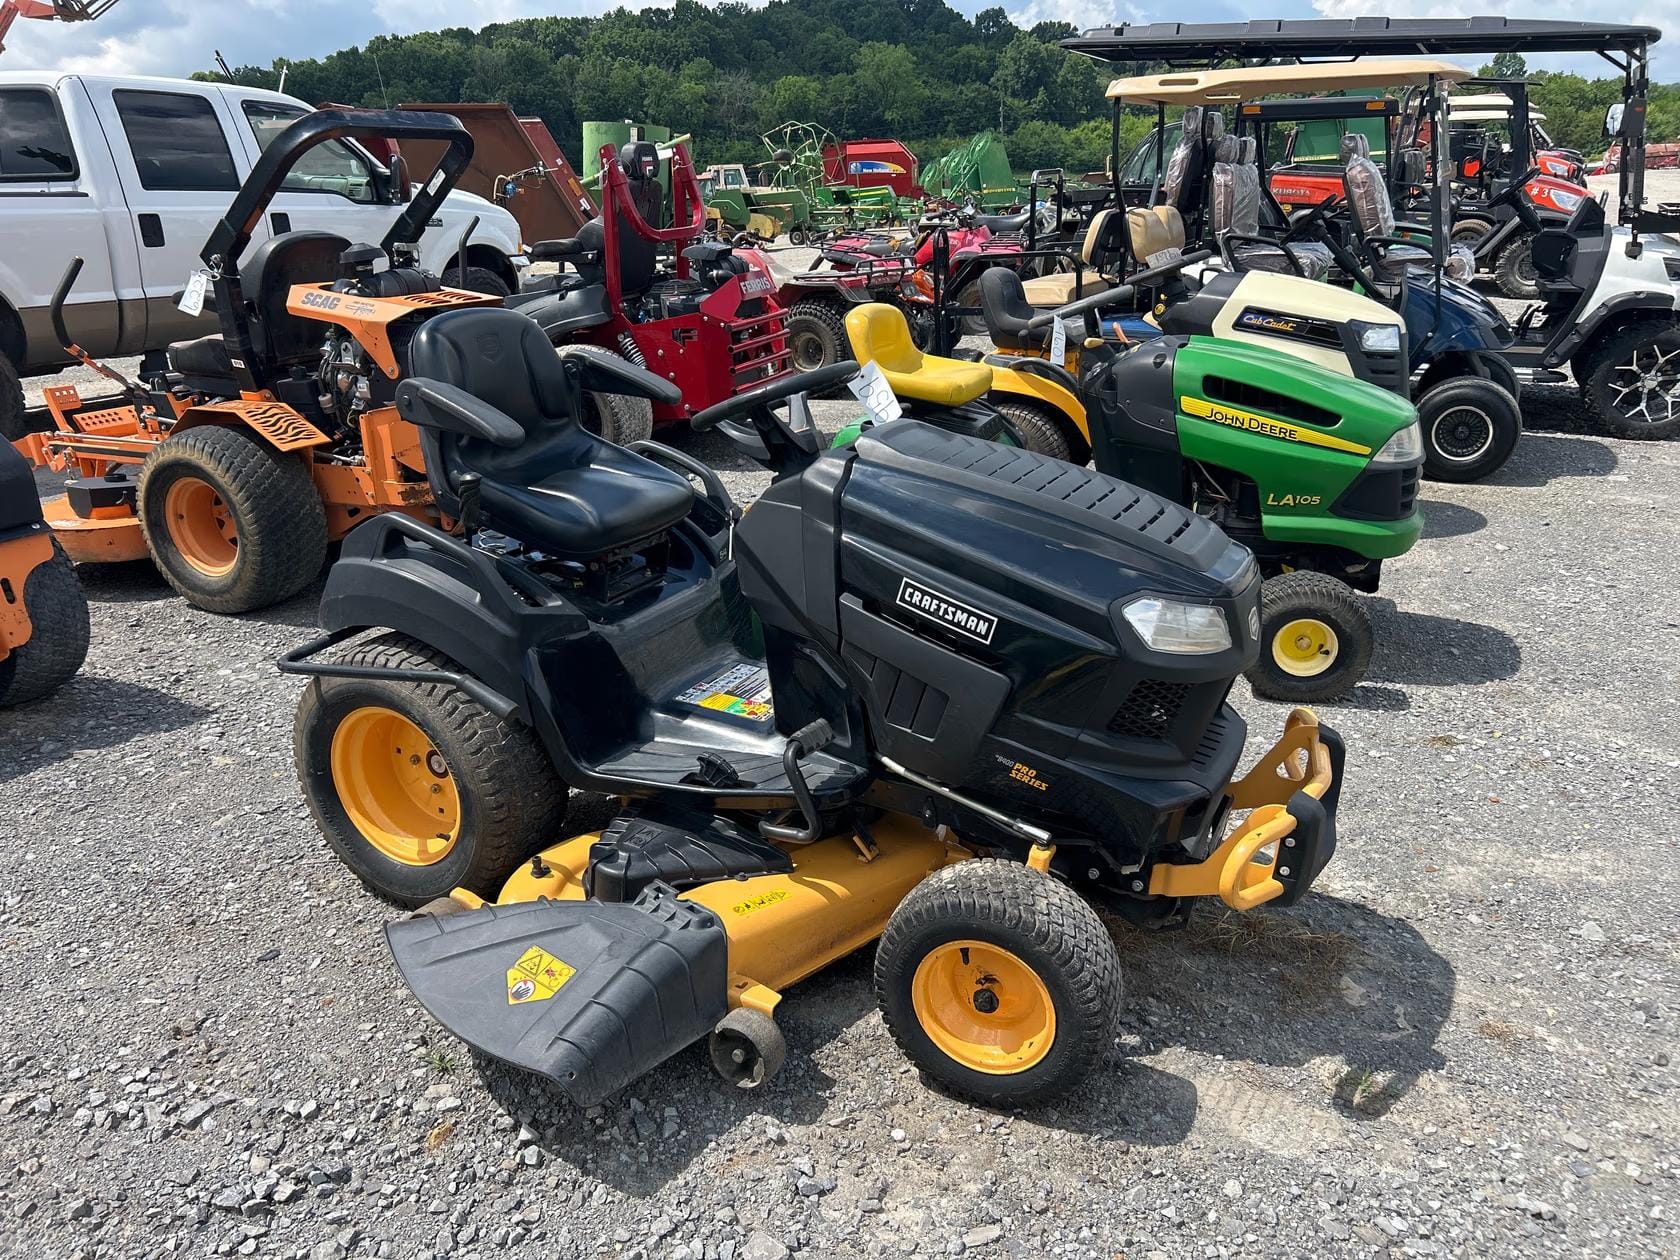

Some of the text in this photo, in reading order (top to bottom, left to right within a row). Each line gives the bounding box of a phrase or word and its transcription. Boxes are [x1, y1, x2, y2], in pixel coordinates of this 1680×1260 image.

[1272, 187, 1311, 196] KUBOTA
[1530, 187, 1549, 198] # 3
[740, 277, 771, 294] FERRIS
[301, 292, 341, 310] SCAG
[1243, 315, 1296, 331] Cub Cadet
[1205, 408, 1298, 440] JOHN DEERE
[1266, 493, 1321, 506] LA105
[904, 587, 989, 635] CRAFTSMAN
[1013, 762, 1037, 777] PRO
[1009, 769, 1049, 791] SERIES
